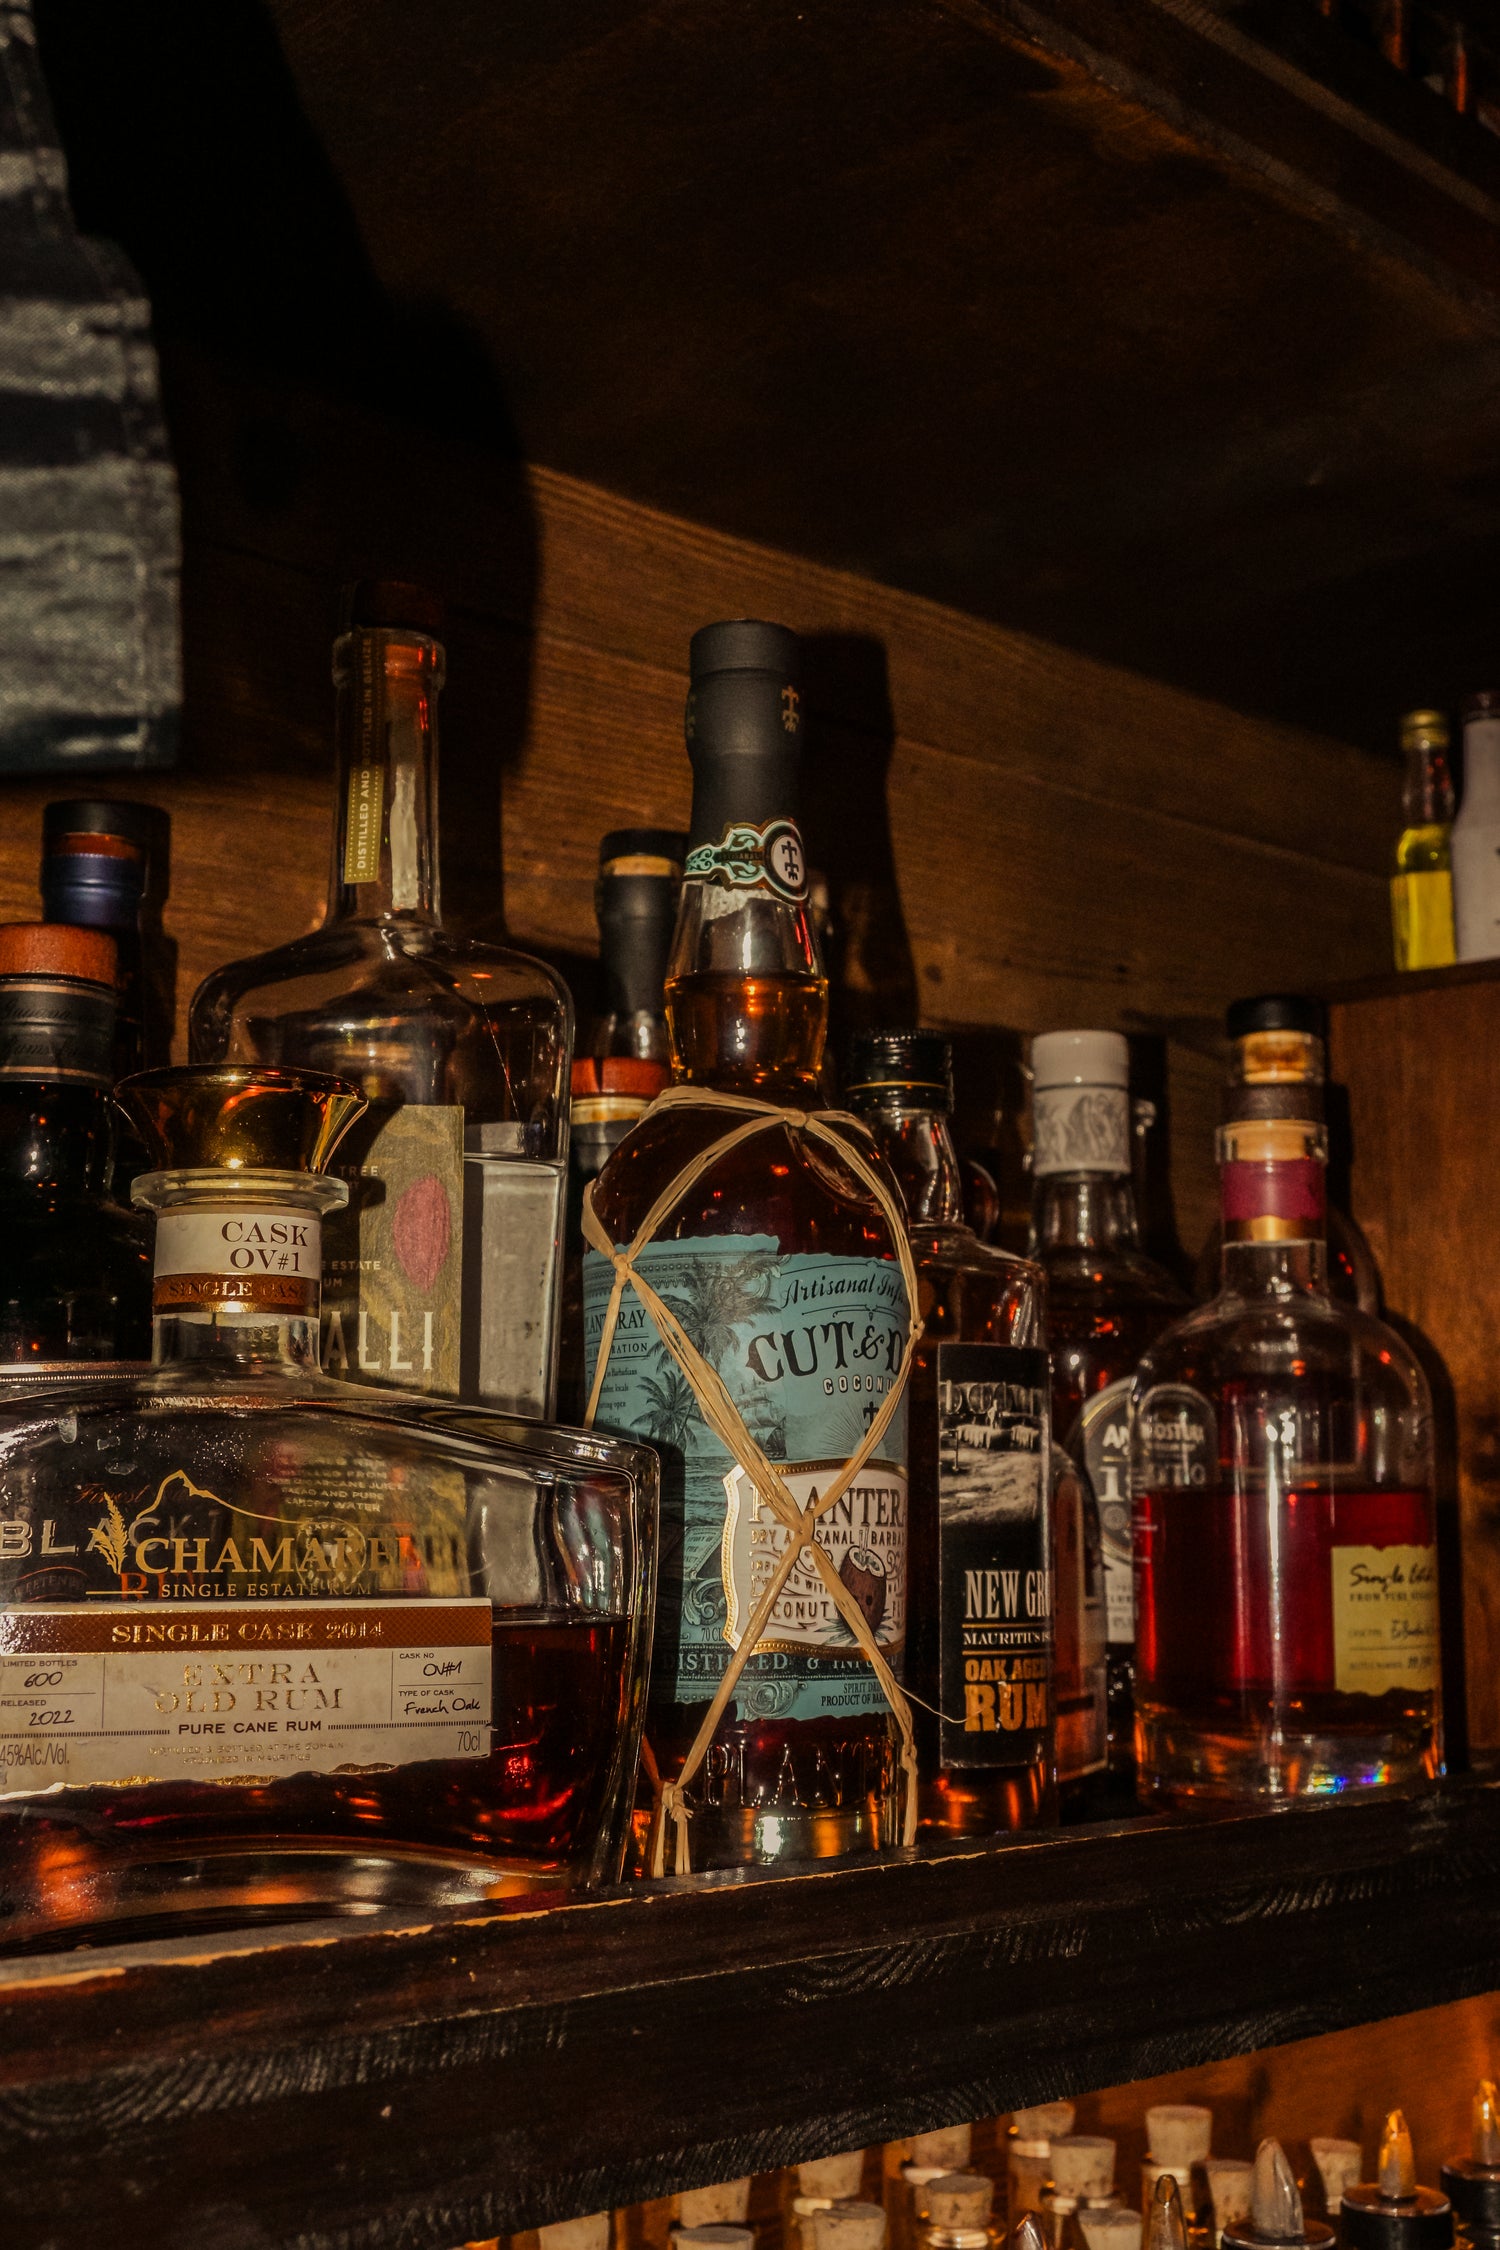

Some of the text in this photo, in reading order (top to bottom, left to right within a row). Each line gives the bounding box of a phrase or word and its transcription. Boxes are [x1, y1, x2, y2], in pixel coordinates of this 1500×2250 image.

[357, 638, 373, 869] DISTILLED AND BOTTLED IN BELIZE
[339, 1166, 379, 1177] TREE
[221, 1221, 310, 1247] CASK
[230, 1248, 302, 1272] OV#1
[331, 1261, 381, 1270] ESTATE
[169, 1281, 300, 1298] SINGLE CAS
[323, 1278, 342, 1287] UM
[781, 1274, 876, 1309] Artisanal
[322, 1311, 434, 1369] ALLI
[823, 1375, 894, 1395] COCONU
[751, 1529, 776, 1544] DRY
[161, 1582, 373, 1598] SINGLE ESTATE RUM
[964, 1570, 1020, 1618] NEW
[748, 1601, 829, 1619] CCONUT
[112, 1621, 385, 1644] SINGLE CASK 2014
[701, 1628, 724, 1642] 70 CL
[963, 1631, 1040, 1645] MAURITIUS
[3, 1660, 36, 1668] LIMITED
[965, 1657, 1047, 1682] OAK AGED
[24, 1671, 63, 1688] 600
[181, 1662, 321, 1687] EXTRA
[843, 1682, 867, 1694] SPIRIT
[1, 1699, 47, 1707] RELEASED
[155, 1687, 343, 1713] OLD RUM
[404, 1698, 480, 1716] French Oak
[821, 1694, 859, 1706] PRODUCT
[862, 1693, 871, 1705] OF
[964, 1682, 1048, 1732] RUM
[28, 1709, 75, 1726] 2022
[178, 1720, 322, 1735] PURE CANE RUM
[217, 1744, 263, 1753] BOTTLED
[282, 1743, 301, 1751] THE
[304, 1742, 344, 1750] DOMAIN
[457, 1730, 481, 1752] 70cl
[258, 1754, 311, 1762] MAURITIUS
